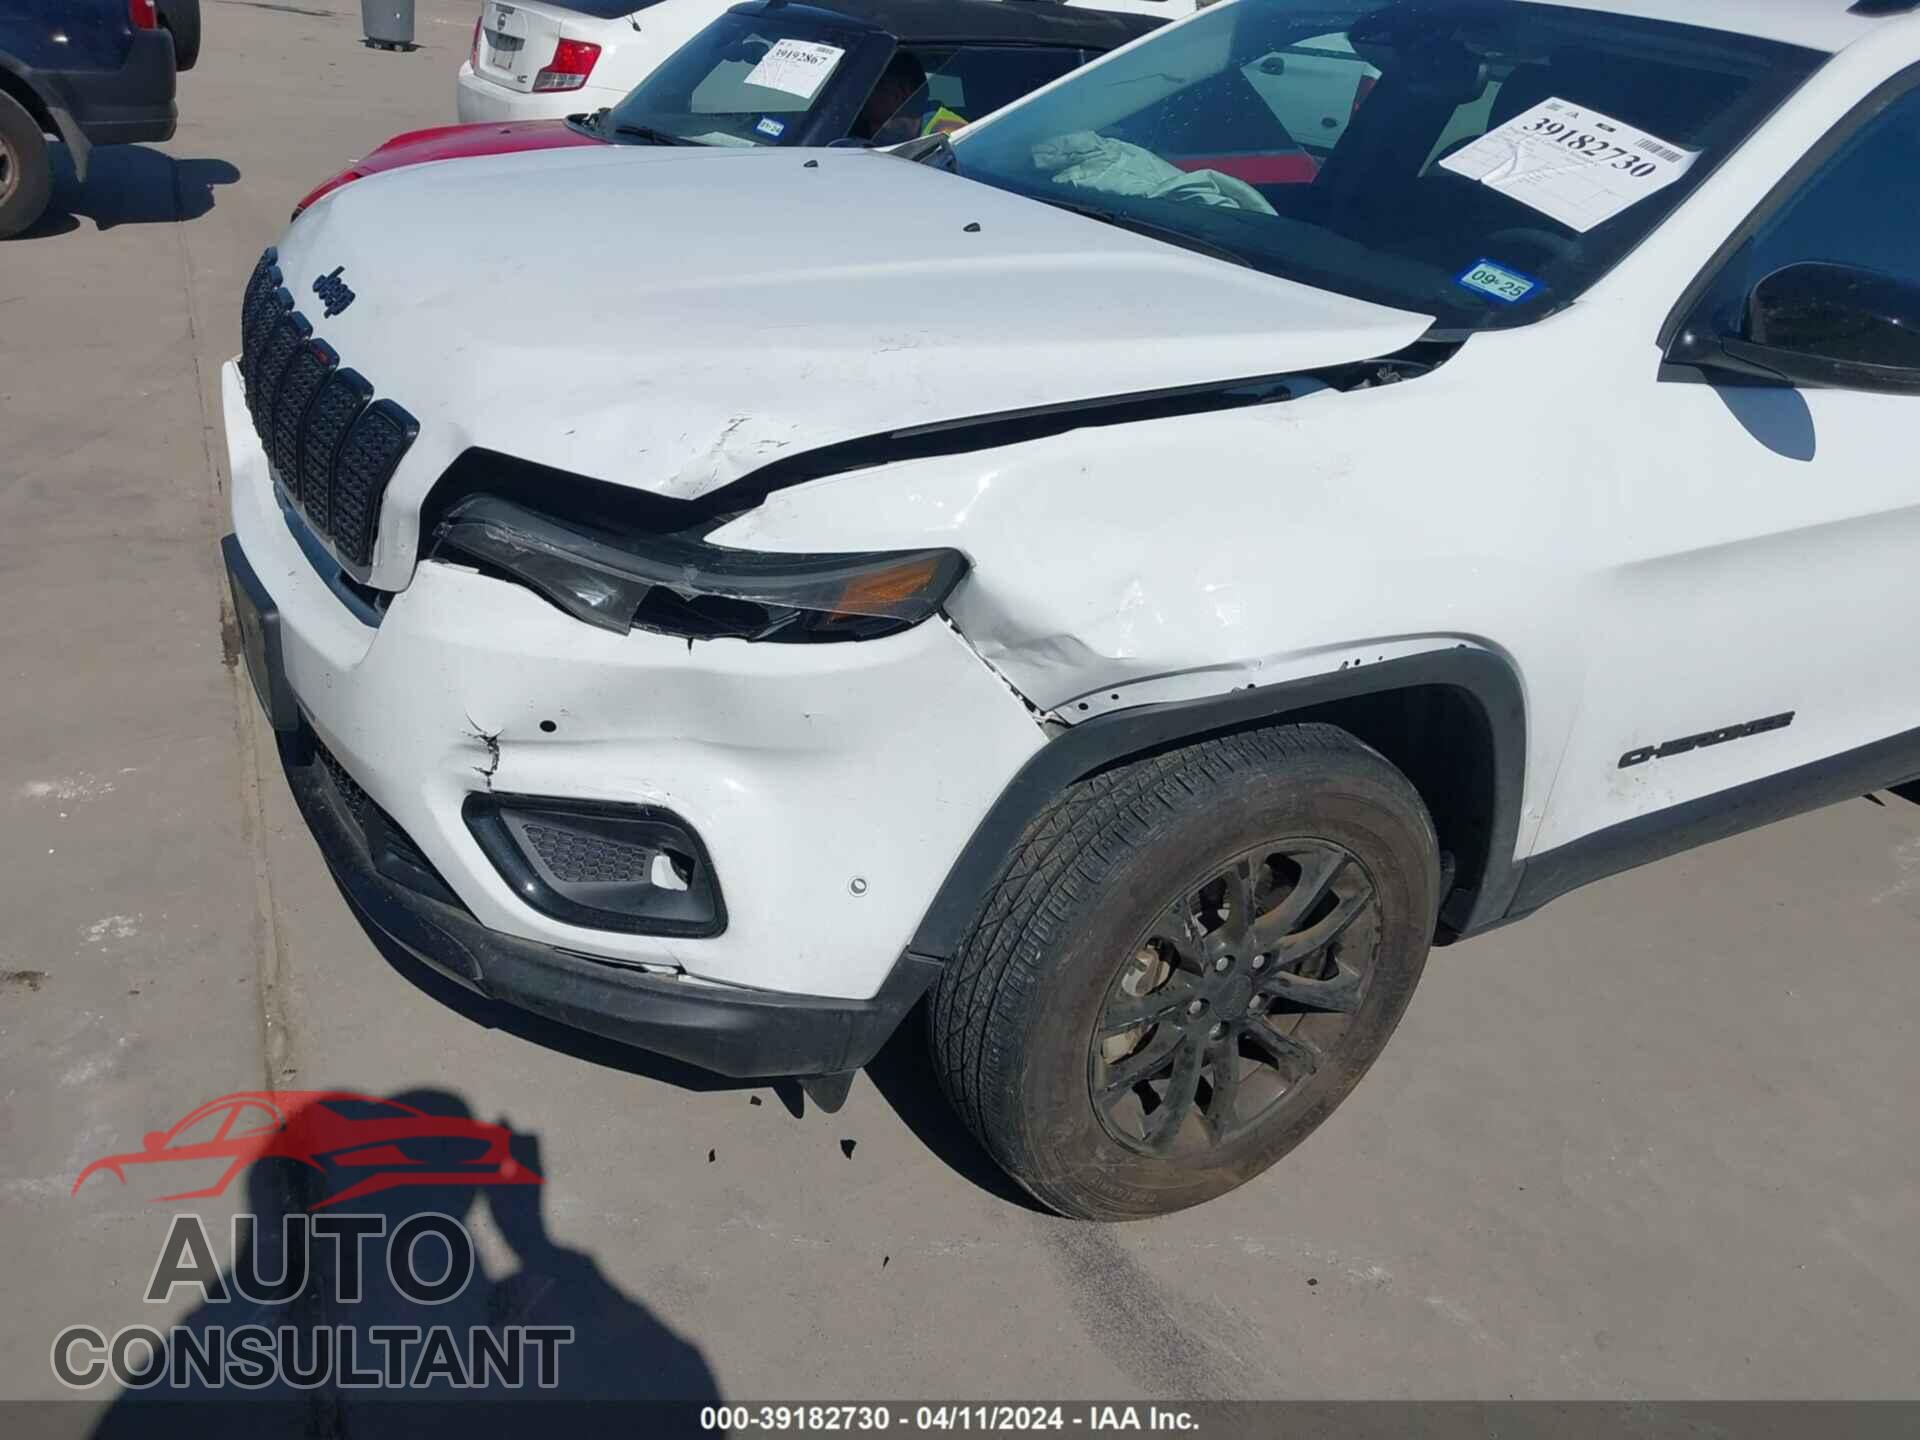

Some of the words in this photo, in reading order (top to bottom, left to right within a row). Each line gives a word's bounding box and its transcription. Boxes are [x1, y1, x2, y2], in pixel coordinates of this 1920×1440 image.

[1522, 116, 1657, 177] 39182730
[1471, 269, 1497, 285] 09
[1498, 281, 1526, 297] 25
